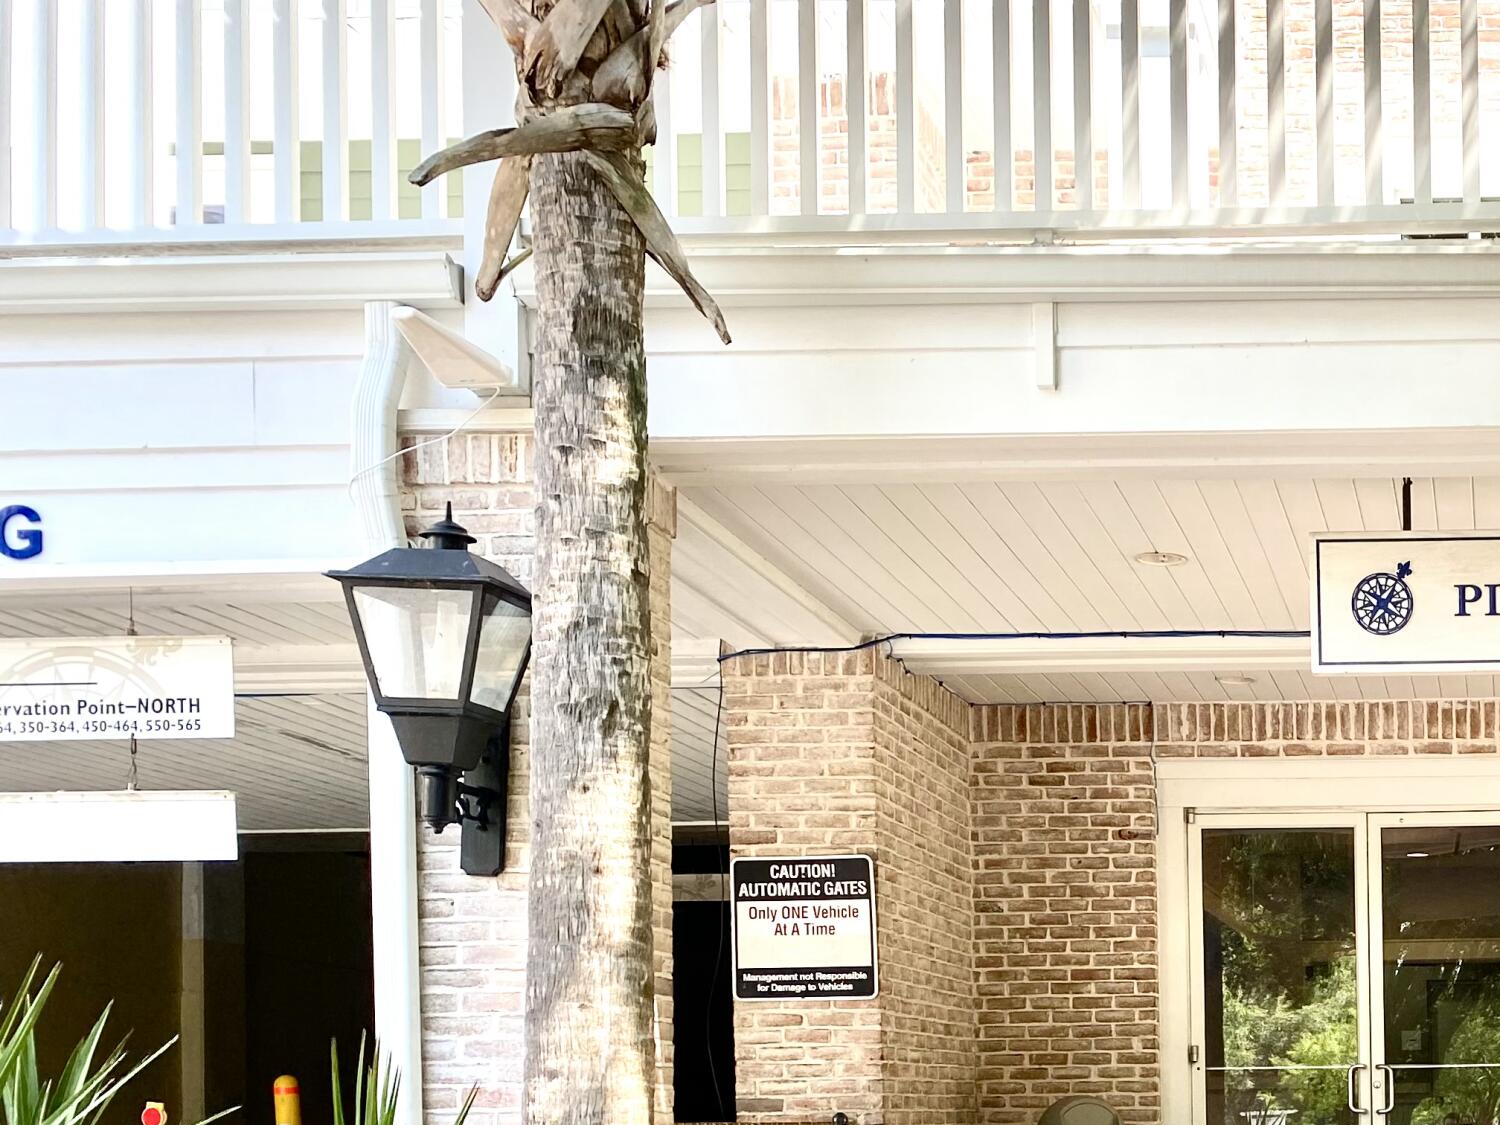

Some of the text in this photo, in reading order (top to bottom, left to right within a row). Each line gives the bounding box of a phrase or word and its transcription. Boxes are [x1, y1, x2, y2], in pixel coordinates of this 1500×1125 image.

[0, 699, 70, 716] rvation
[146, 718, 201, 731] 550-565
[769, 863, 836, 879] CAUTION!
[738, 880, 868, 897] AUTOMATIC GATES
[748, 904, 859, 922] Only ONE Vehicle
[774, 922, 836, 936] At A Time
[742, 971, 868, 983] Management not Responsible
[757, 981, 854, 993] for Damage to Vehicles
